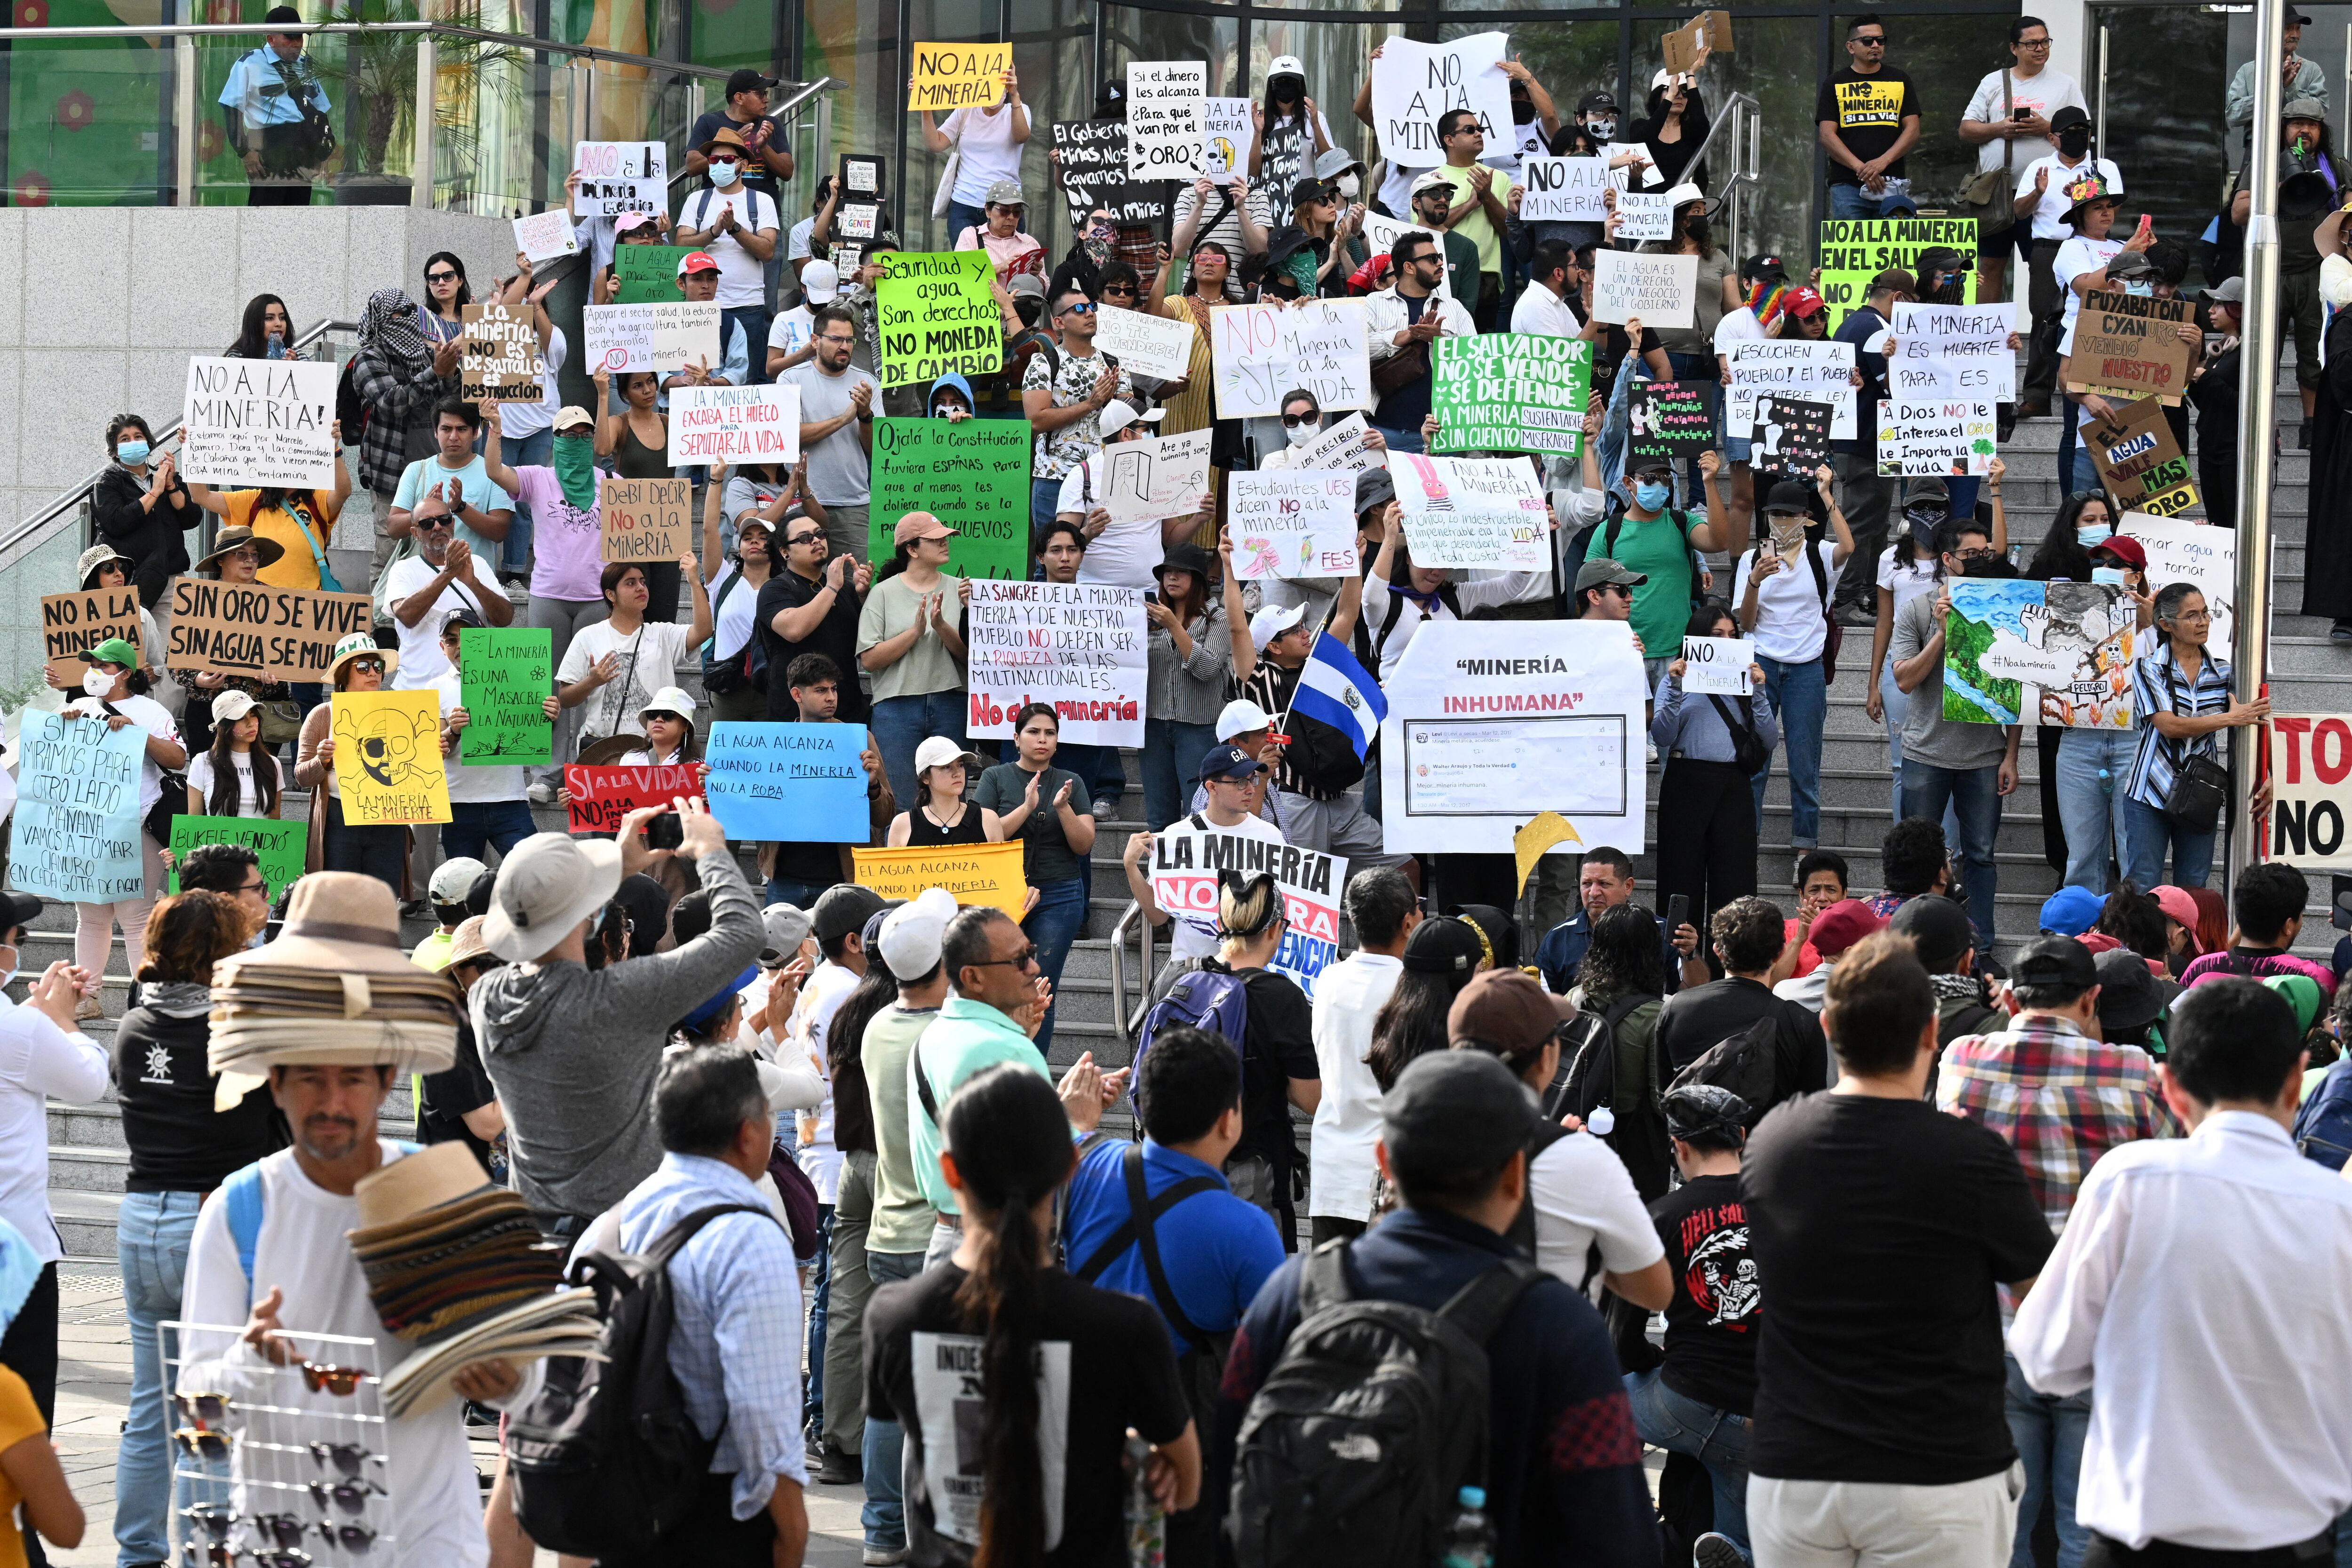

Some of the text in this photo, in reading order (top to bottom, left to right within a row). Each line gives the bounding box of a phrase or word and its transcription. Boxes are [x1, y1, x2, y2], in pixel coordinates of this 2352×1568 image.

[919, 52, 1003, 76] NO A LA
[1151, 71, 1162, 82] el
[1165, 67, 1200, 82] dinero
[917, 79, 992, 105] MINERÍA
[1157, 85, 1200, 98] alcanza
[1132, 103, 1192, 121] ¿Para qué
[1135, 119, 1197, 137] van por el
[1527, 161, 1606, 192] NO A LA
[1526, 194, 1603, 217] MINERÍA
[1622, 196, 1668, 207] NO A LA
[1637, 228, 1645, 237] la
[1616, 260, 1675, 275] EL AGUA ES
[1613, 273, 1675, 287] UN DERECHO,
[1601, 283, 1681, 299] NO UN NEGOCIO
[1611, 295, 1680, 310] DEL GOBIERNO
[2085, 289, 2186, 322] PUYABOTÓN
[583, 307, 618, 325] ¡Apoyar
[620, 308, 627, 318] el
[630, 307, 654, 318] sector
[682, 306, 691, 316] la
[1896, 311, 2006, 335] LA MINERIA
[588, 318, 712, 338] ción y la agricultura, también
[2102, 315, 2177, 347] CYANURO
[589, 334, 649, 350] es desarrollo!
[1907, 340, 2000, 358] ES MUERTE
[2079, 334, 2142, 358] VENDIÓ
[609, 347, 687, 366] NO a la minería
[194, 365, 301, 400] NO A LA
[1899, 369, 1938, 388] PARA
[2101, 358, 2172, 388] NUESTRO
[190, 398, 325, 431] MINERÍA!
[188, 430, 225, 440] Estamos
[230, 431, 249, 444] aquí
[254, 435, 270, 444] por
[189, 441, 224, 452] Ramiro,
[227, 442, 251, 452] Dora
[272, 443, 286, 453] las
[188, 453, 199, 463] de
[243, 455, 258, 467] que
[265, 453, 276, 463] los
[310, 459, 333, 468] morir
[183, 464, 208, 478] TODA
[213, 465, 239, 477] mina
[970, 583, 1138, 608] LA SANGRE DE LA MADRE
[173, 582, 369, 634] SIN ORO SE VIVE
[972, 605, 1124, 629] TIERRA Y DE NUESTRO
[169, 624, 297, 666] SIN AGUA SE
[972, 626, 1138, 652] PUEBLO NO DEBEN SER
[972, 649, 1119, 670] LA RIQUEZA DE LAS
[1683, 637, 1738, 665] ¡NO A LA
[1991, 654, 2057, 670] #Noalaminería
[972, 669, 1116, 691] MULTINACIONALES.
[2074, 683, 2105, 692] PELIGRO
[732, 734, 768, 749] AGUA
[713, 758, 855, 777] CUANDO LA MINERIA
[710, 782, 727, 794] NO
[731, 782, 746, 795] LA
[2273, 799, 2344, 856] NO
[1681, 1206, 1717, 1252] HELL
